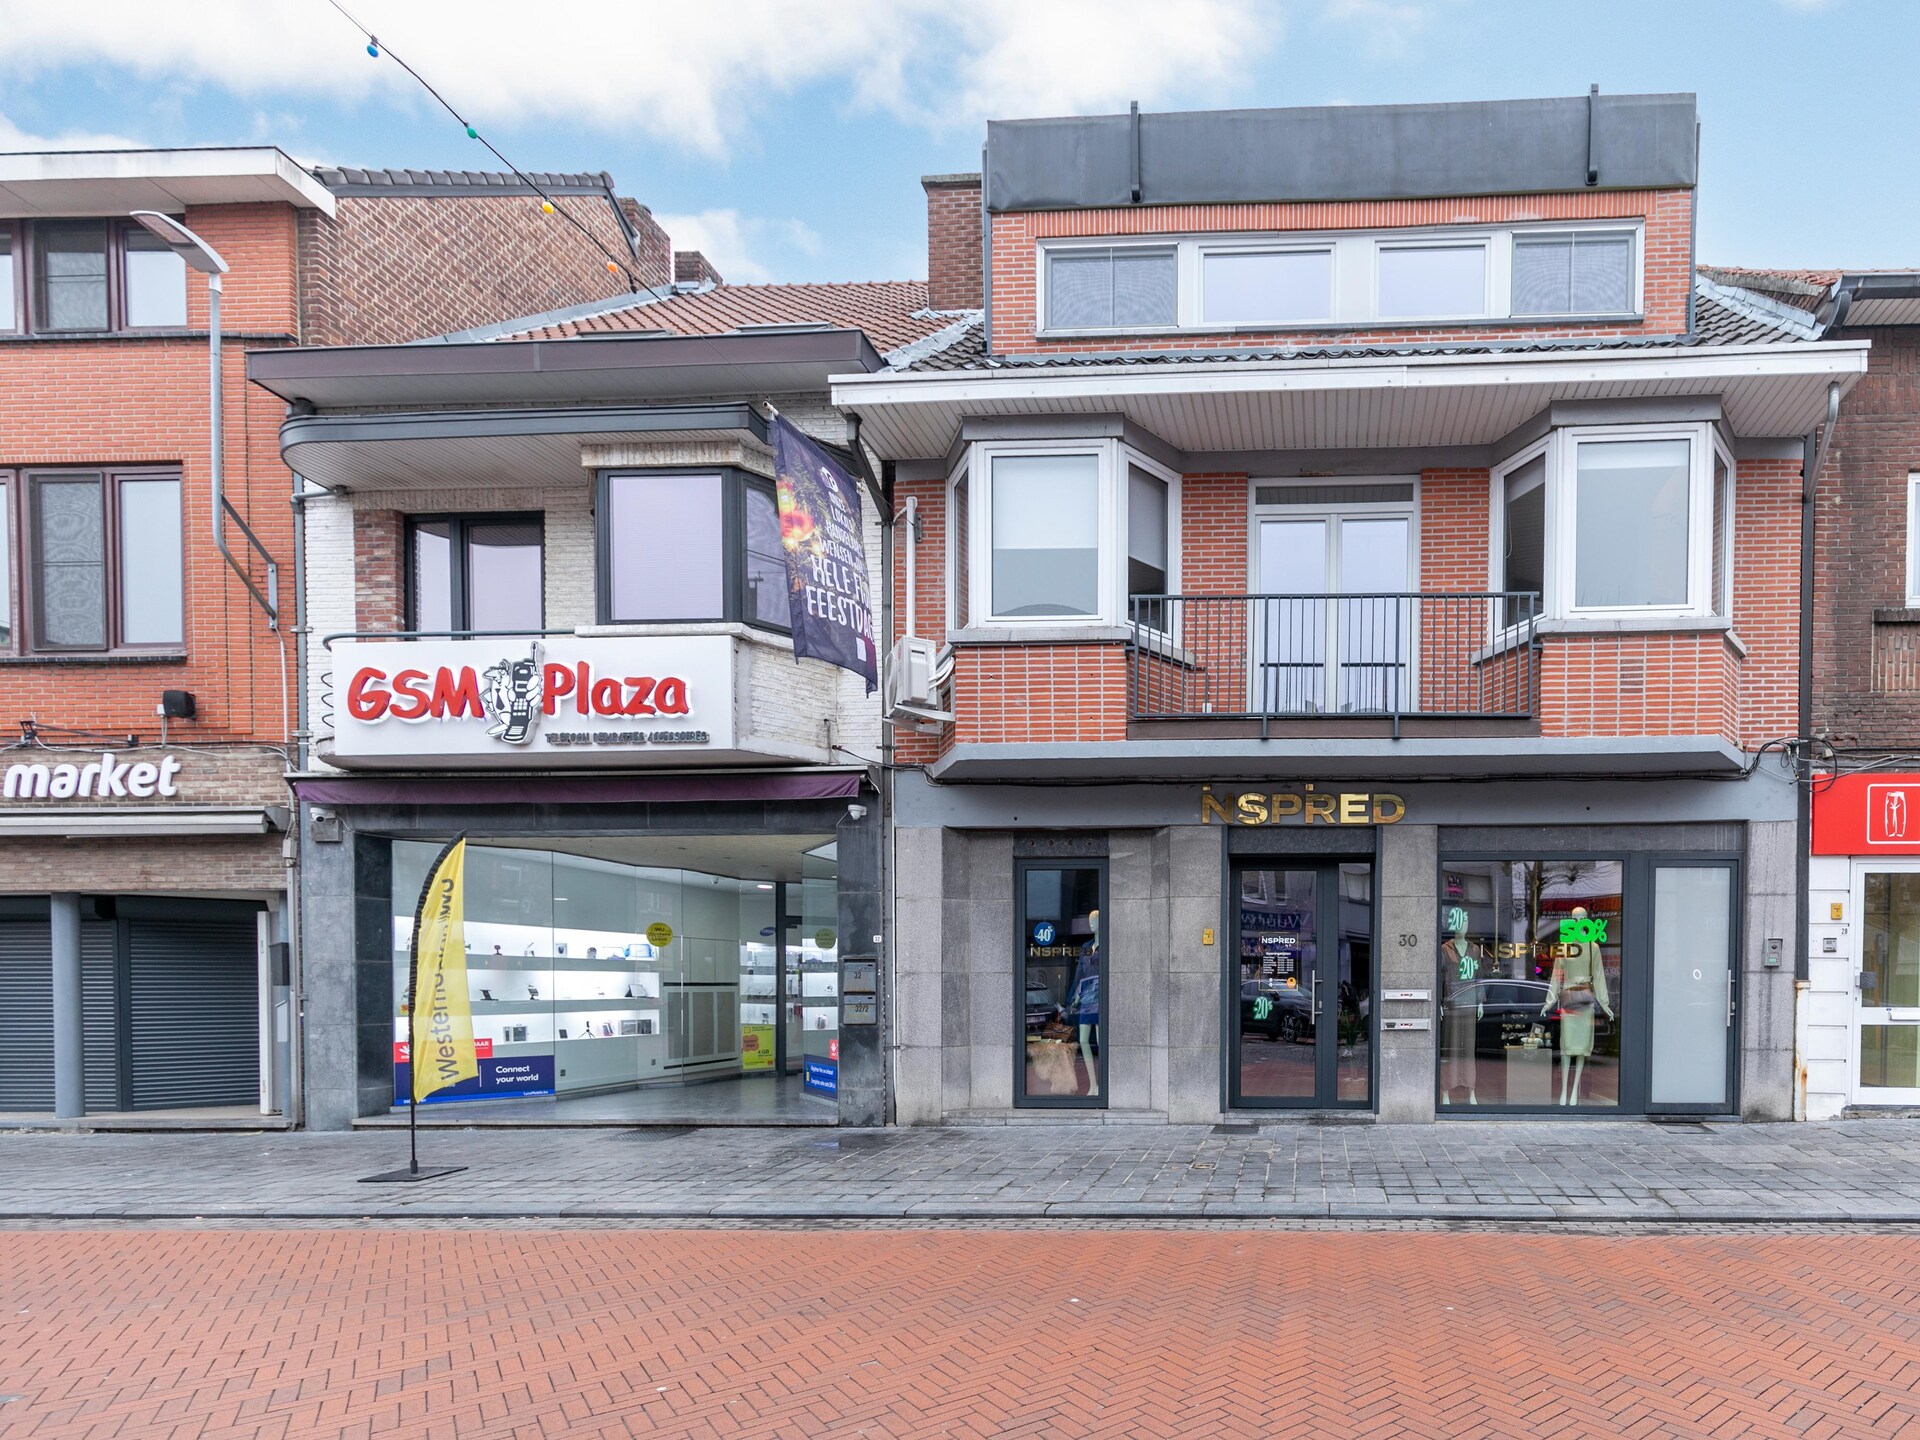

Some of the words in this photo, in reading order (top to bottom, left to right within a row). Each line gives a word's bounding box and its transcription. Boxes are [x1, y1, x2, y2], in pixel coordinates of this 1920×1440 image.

[810, 554, 852, 595] HELE
[347, 665, 485, 721] GSM
[543, 660, 689, 716] Plaza
[3, 752, 182, 798] market
[1399, 934, 1418, 947] 30
[1559, 918, 1608, 943] 50%
[495, 1064, 530, 1074] Connect
[495, 1076, 514, 1084] your
[516, 1074, 539, 1082] world
